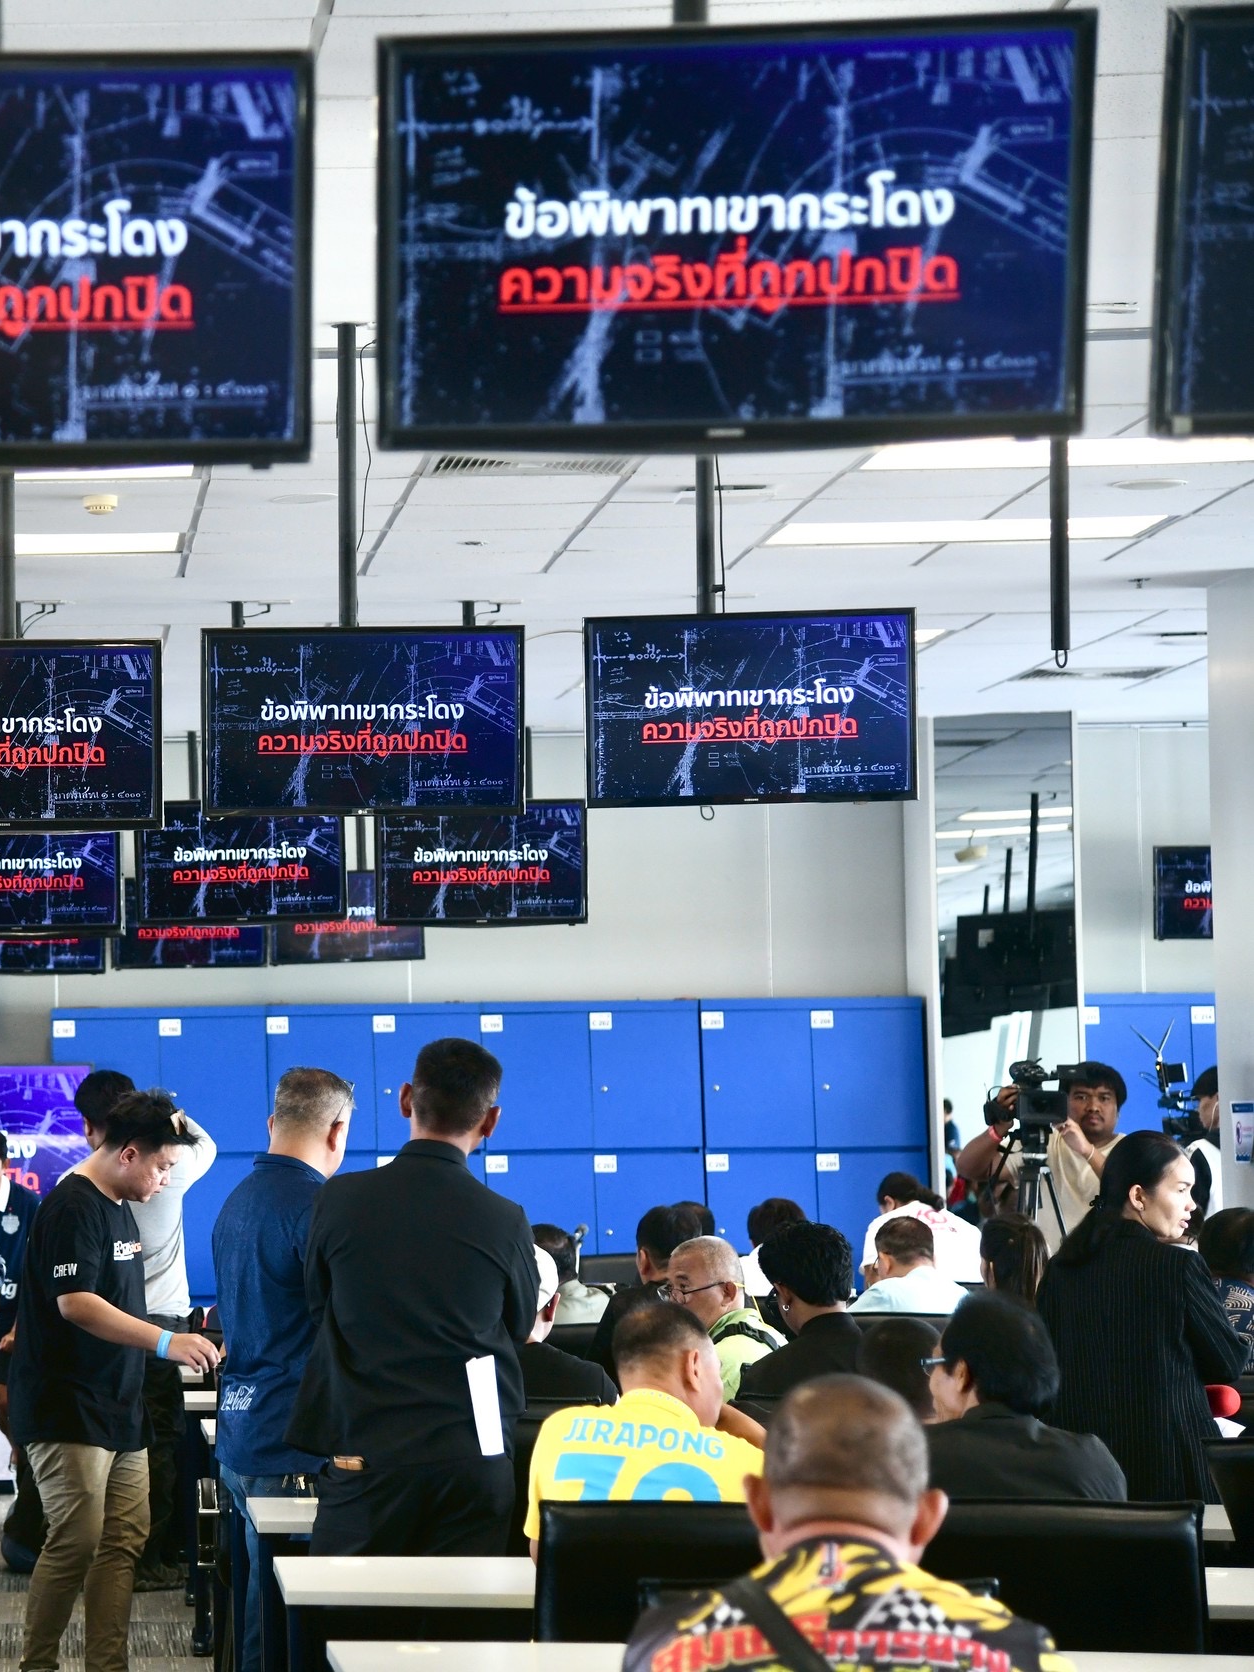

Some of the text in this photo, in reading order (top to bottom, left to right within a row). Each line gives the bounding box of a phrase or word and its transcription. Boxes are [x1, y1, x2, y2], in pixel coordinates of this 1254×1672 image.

[504, 170, 955, 239] ข้อพิพาทเขากระโดง
[498, 236, 959, 314] ความจริงที่ถูกปกปิด
[260, 694, 465, 721] ข้อพิพาทเขากระโดง
[644, 678, 855, 709] ข้อพิพาทเขากระโดง
[258, 722, 468, 757] ความจริงที่ถูกปกปิด
[642, 709, 859, 743] ความจริงที่ถูกปกปิด
[173, 842, 307, 862] ข้อพิพาทเขากระโดง
[414, 843, 549, 863] ข้อพิพาทเขากระโดง
[173, 862, 309, 884] ความจริงที่ถูกปกปิด
[412, 864, 550, 886] ความจริงที่ถูกปกปิด
[53, 1263, 78, 1278] CREW
[563, 1418, 724, 1459] JIRAPONG
